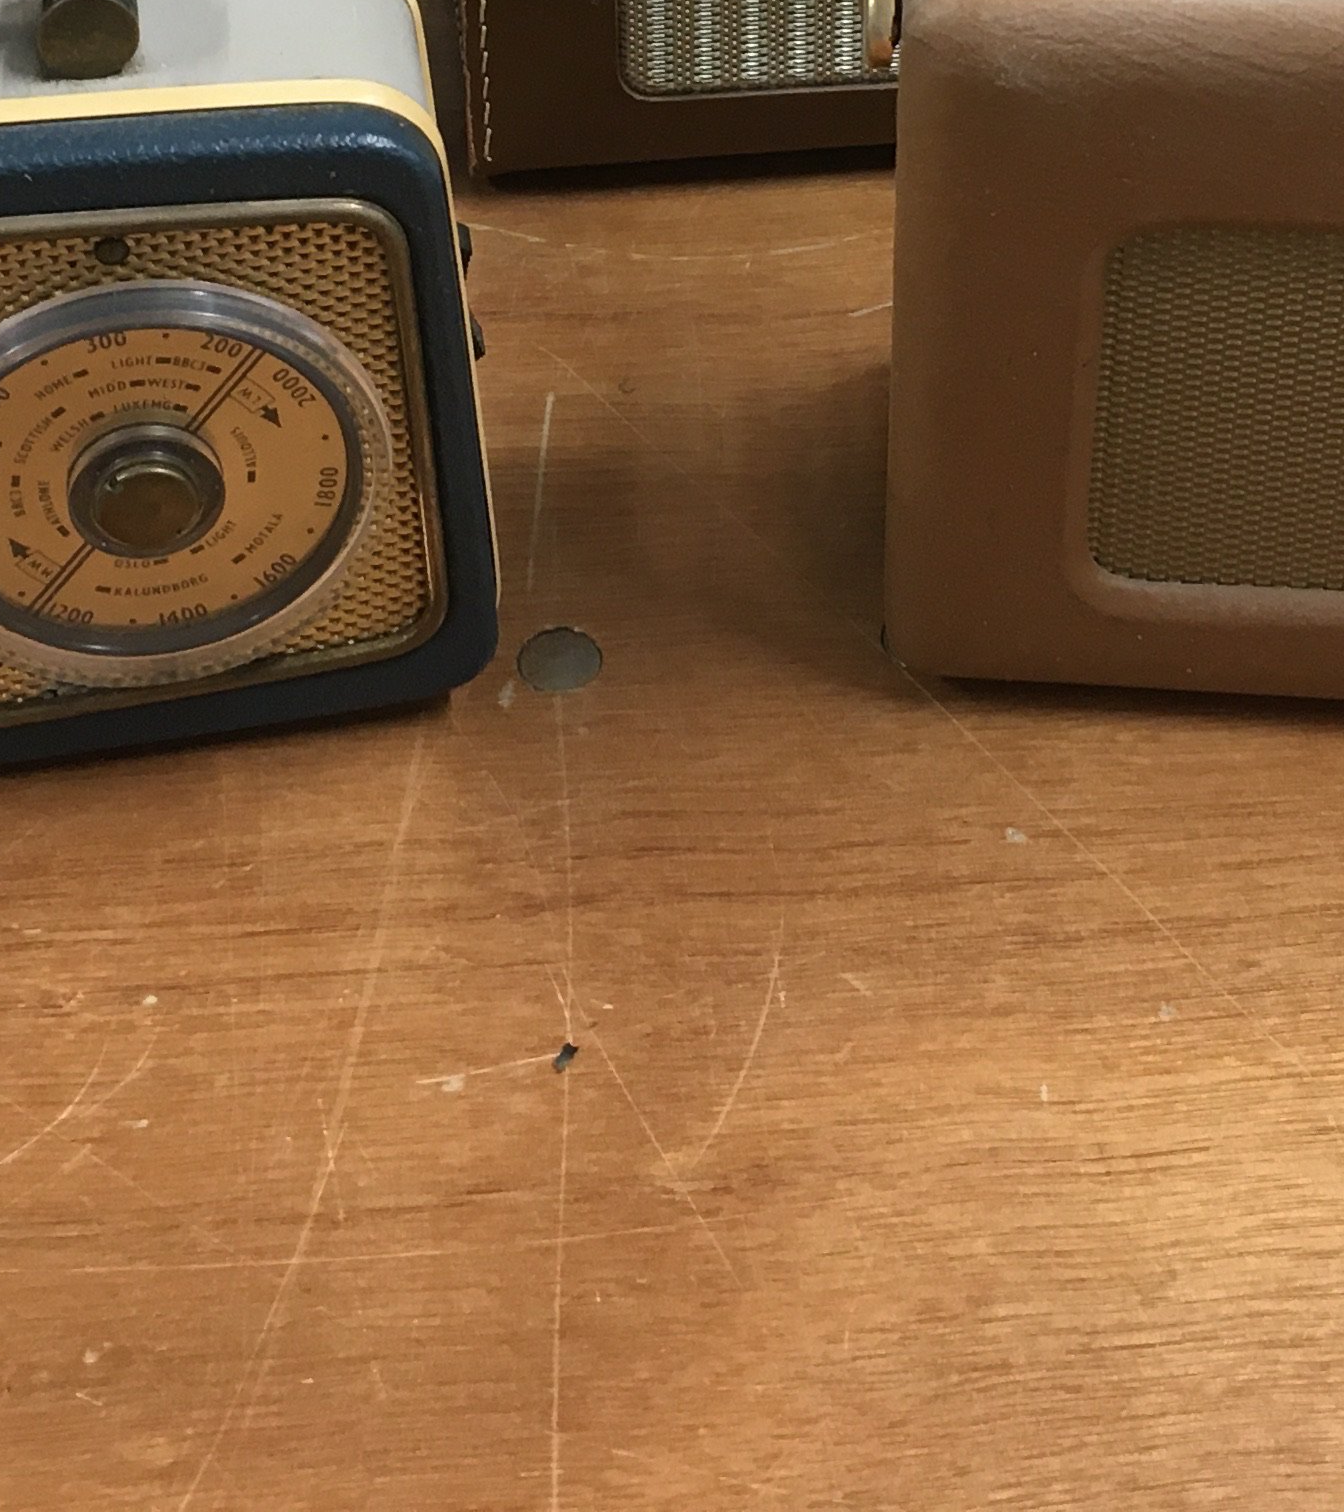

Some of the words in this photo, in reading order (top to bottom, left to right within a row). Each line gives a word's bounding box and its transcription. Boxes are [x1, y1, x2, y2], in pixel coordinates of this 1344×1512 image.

[86, 331, 127, 354] 300
[200, 334, 243, 358] 200
[111, 355, 154, 370] LIGHT
[34, 375, 74, 400] HOME
[88, 380, 127, 399] MIDD
[147, 377, 187, 390] WEST
[272, 368, 318, 408] 2000
[13, 415, 54, 466] SCOTTISH
[51, 417, 92, 454] WELSH
[230, 426, 257, 468] ALLOUIS
[314, 467, 339, 507] 1800
[37, 480, 61, 526] ATHLONE
[205, 519, 238, 550] LIGHT
[245, 512, 284, 554] MOTALA
[114, 559, 151, 569] OSLO
[253, 552, 296, 588] 1600
[112, 573, 210, 597] KALUNDBORG
[159, 603, 208, 627] 1400
